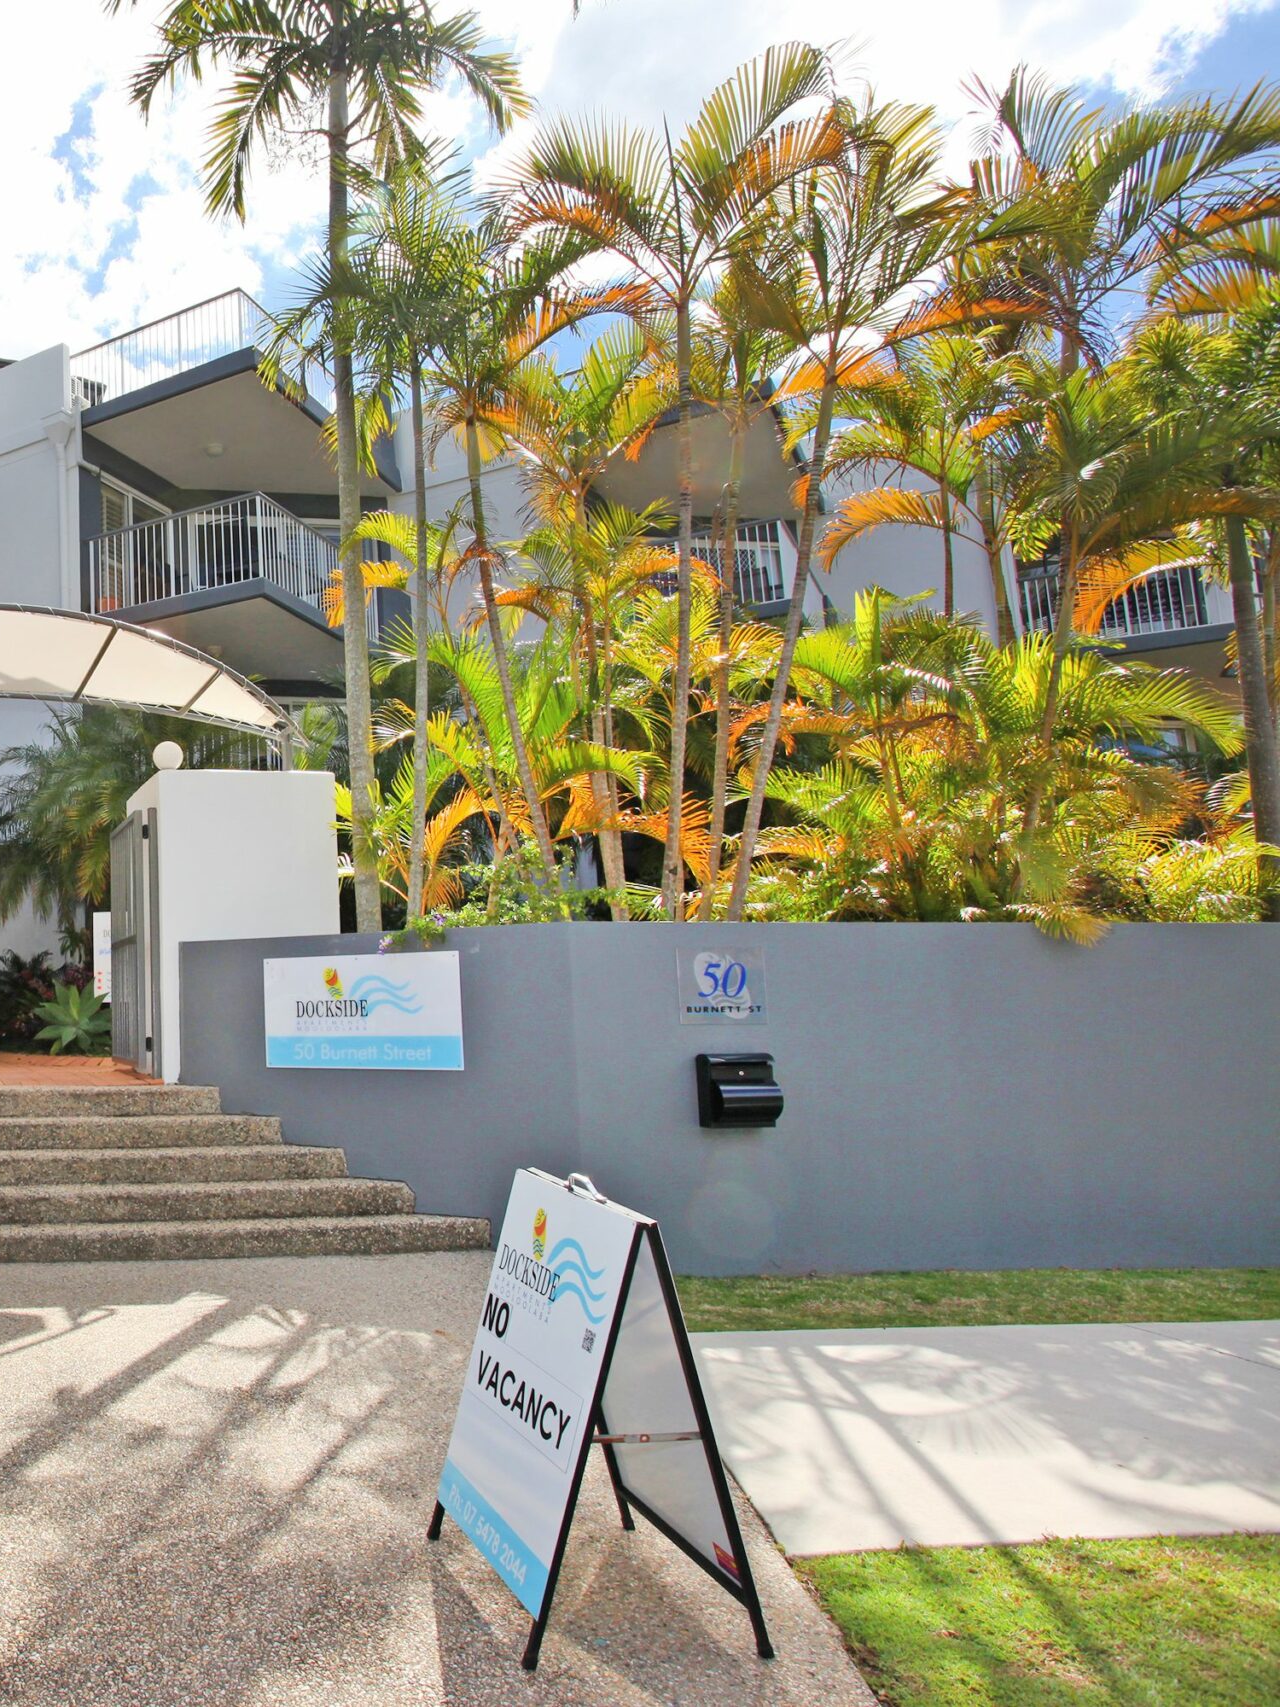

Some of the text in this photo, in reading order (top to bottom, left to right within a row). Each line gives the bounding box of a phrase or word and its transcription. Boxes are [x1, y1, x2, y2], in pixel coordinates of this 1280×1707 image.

[698, 962, 747, 998] 50
[296, 999, 369, 1018] DOCKSIDE
[686, 1005, 762, 1014] BURNETT ST
[294, 1043, 432, 1061] 50 Burnett Street
[499, 1243, 560, 1302] DOCKSIDE
[482, 1293, 510, 1338] NO
[477, 1349, 571, 1450] VACANCY
[448, 1483, 527, 1586] Ph: 07 5478 2044
